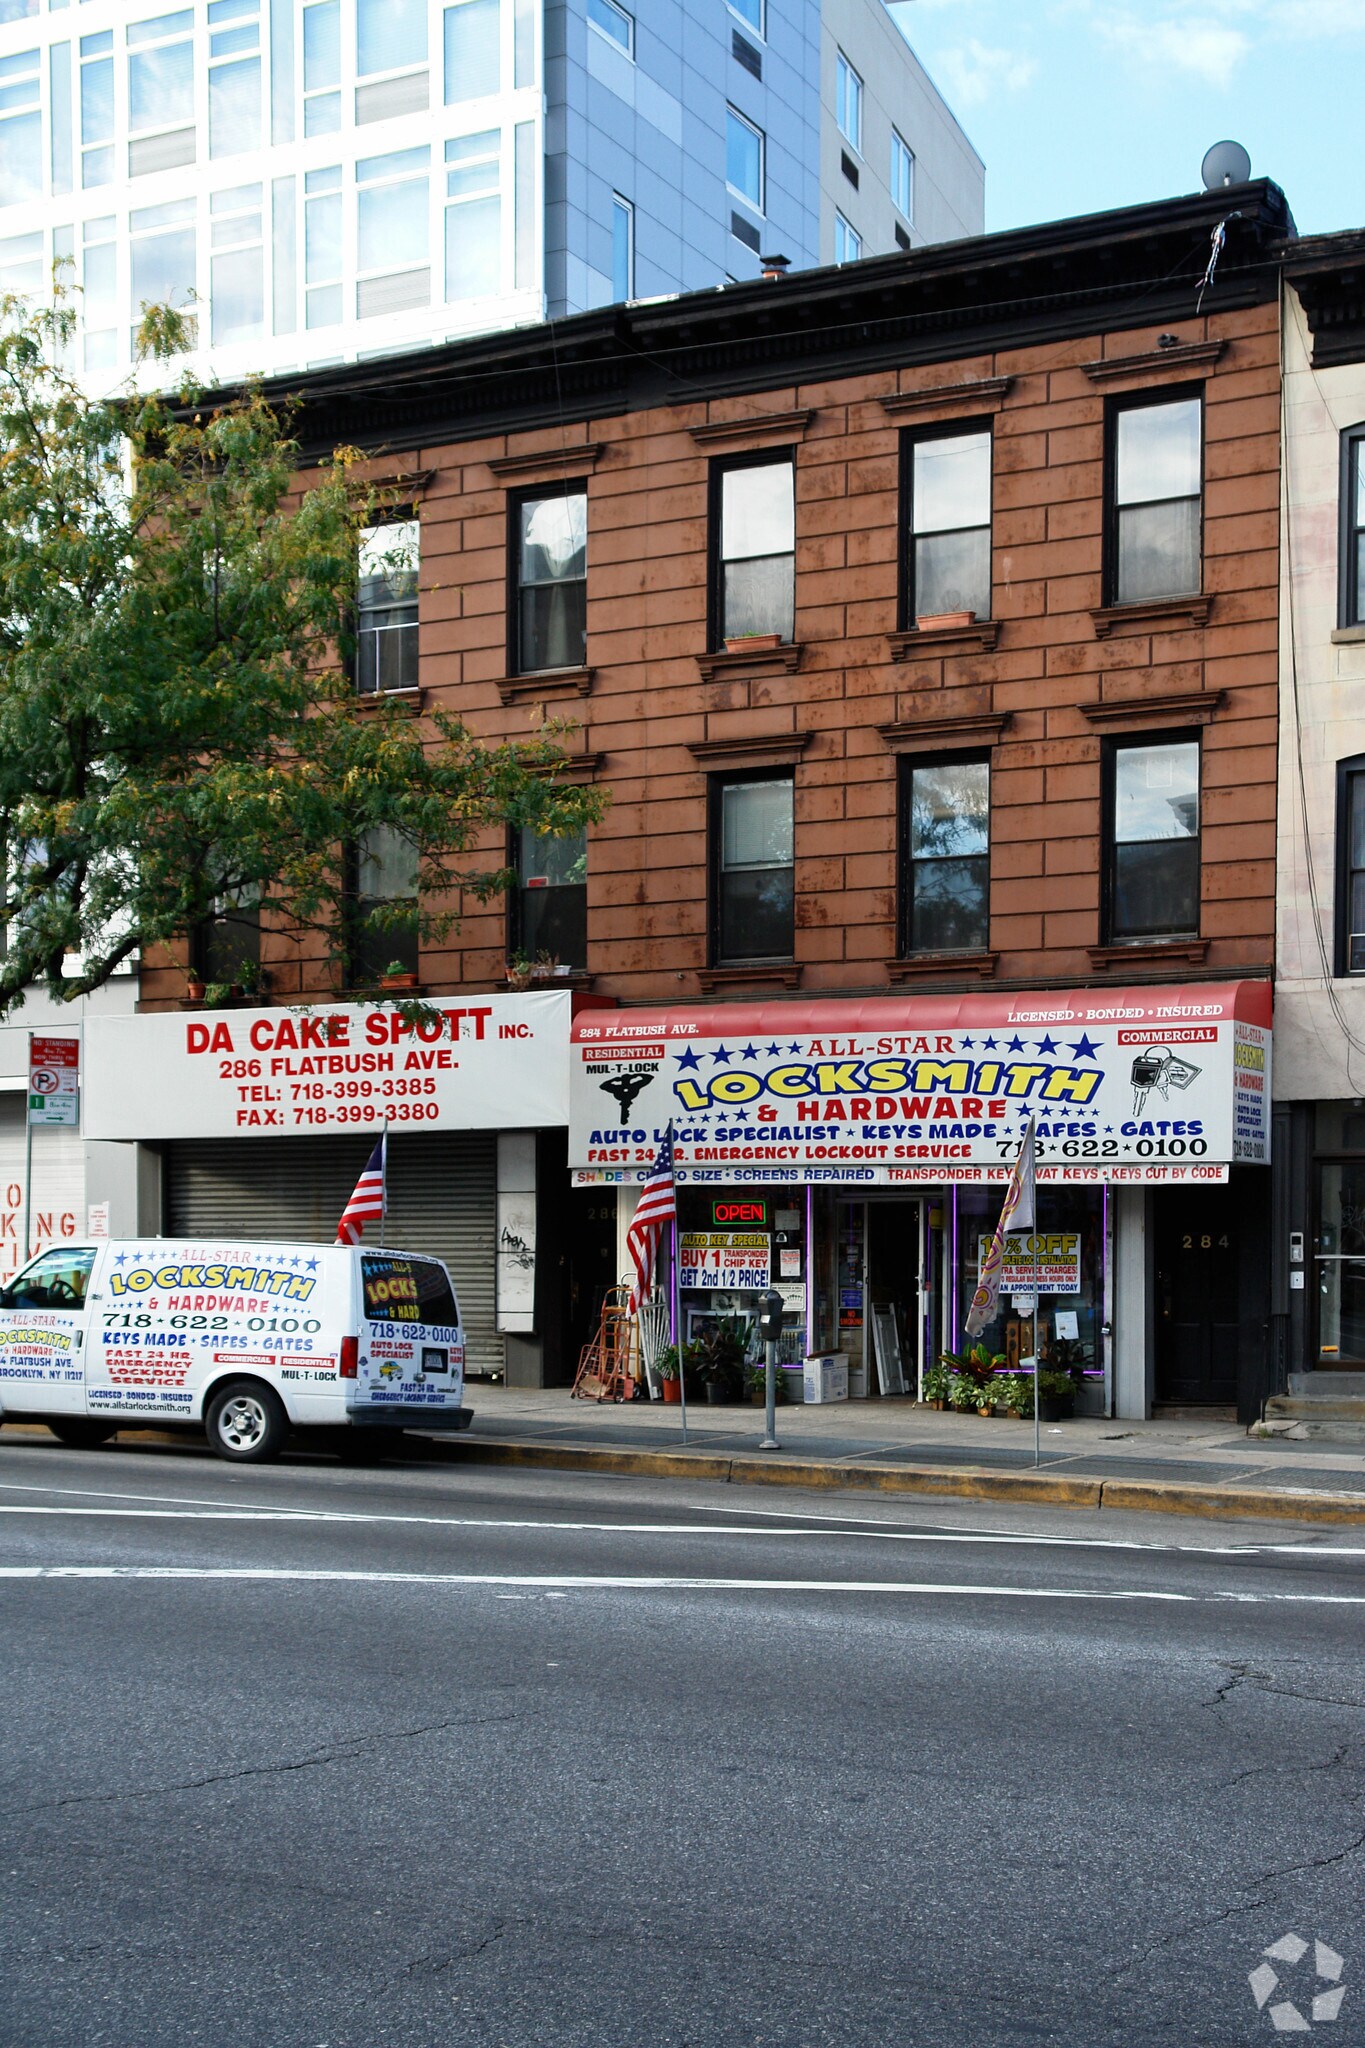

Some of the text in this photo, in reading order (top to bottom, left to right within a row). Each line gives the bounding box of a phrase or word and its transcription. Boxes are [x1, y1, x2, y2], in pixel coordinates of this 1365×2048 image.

[1008, 1005, 1223, 1022] LICENSED BONDED INSURED
[187, 1007, 534, 1054] DA CAKE SPOTT INC.
[579, 1023, 699, 1038] 284 FLATBUSH AVE.
[1121, 1030, 1214, 1043] COMMERCIAL
[585, 1047, 662, 1059] RESIDENTIAL
[807, 1036, 956, 1057] ALL-STAR
[1234, 1042, 1264, 1072] LOCKSMITH
[219, 1049, 460, 1079] 286 FLATBUSH AVE.
[586, 1062, 659, 1074] MUL-T-LOCK
[238, 1077, 436, 1102] TEL: 718-399-3385
[673, 1057, 1105, 1111] LOCKSMITH
[1239, 1074, 1264, 1092] HARDWARE
[236, 1102, 439, 1126] FAX: 718-399-3380
[757, 1096, 1007, 1122] & HARDWARE
[589, 1129, 646, 1144] AUTO
[714, 1125, 840, 1142] SPECIALIST
[862, 1124, 922, 1139] KEYS
[929, 1124, 997, 1139] MADE
[1120, 1120, 1203, 1136] GATES
[588, 1144, 972, 1162] FAST 24 R. EMERGENCY LOCKOUT SERVICE
[1062, 1139, 1119, 1157] 622
[1136, 1138, 1208, 1156] 0100
[577, 1171, 631, 1182] SHADES
[692, 1170, 722, 1181] SIZE
[734, 1169, 798, 1180] SCREENS
[804, 1169, 874, 1180] REPAIRED
[887, 1168, 981, 1180] TRANSPONDER
[987, 1167, 1013, 1179] KEY
[1063, 1168, 1098, 1179] KEYS
[1111, 1167, 1141, 1179] KEYS
[1146, 1167, 1168, 1179] CUT
[1172, 1167, 1187, 1178] BY
[1192, 1167, 1222, 1178] CODE
[715, 1204, 763, 1221] OPEN
[682, 1234, 768, 1246] AUTO KEY SPECIAL
[980, 1235, 1078, 1254] 1% OFF
[1183, 1235, 1229, 1248] 284
[179, 1249, 252, 1264] ALL-STAR
[681, 1249, 720, 1267] BUY 1
[724, 1250, 768, 1258] TRANSPONDER
[1039, 1255, 1077, 1265] INSTALLATION
[724, 1259, 768, 1268] CHIP KEY
[1016, 1266, 1043, 1274] SERVIE
[109, 1264, 316, 1302] LOCKSMITH
[680, 1269, 698, 1286] GET
[702, 1269, 718, 1286] 2nd
[739, 1269, 769, 1287] PRICE!
[366, 1277, 418, 1304] LOCKS
[1010, 1284, 1055, 1292] APPOINMENT
[1057, 1284, 1078, 1292] TODAY
[148, 1295, 270, 1314] & HARDWARE
[397, 1305, 420, 1319] HARD
[11, 1315, 56, 1326] ALL-STAR
[102, 1313, 322, 1334] 718 622 0100
[369, 1322, 458, 1343] 718 622 0100
[102, 1331, 313, 1351] KEYS MADE SAFES GATES
[370, 1341, 413, 1350] AUTO LOCK
[12, 1346, 53, 1356] HARDWARE
[105, 1349, 142, 1358] FAST
[170, 1352, 194, 1360] HR.
[370, 1350, 414, 1359] SPECIALIST
[10, 1356, 74, 1368] FLATBUSH AVE.
[105, 1359, 192, 1368] EMERGENCY
[218, 1355, 333, 1367] COMMERCIAL RESIDENTIAL
[49, 1370, 61, 1379] NY
[64, 1371, 83, 1381] 11217
[108, 1368, 187, 1377] LOCKOUT
[281, 1370, 337, 1381] MUL-T-LOCK
[111, 1377, 185, 1386] SERVICE
[400, 1383, 416, 1392] FAST
[88, 1390, 193, 1402] LICENSED BONDED INSURED
[89, 1401, 191, 1414] www.allstarlocksmith.org
